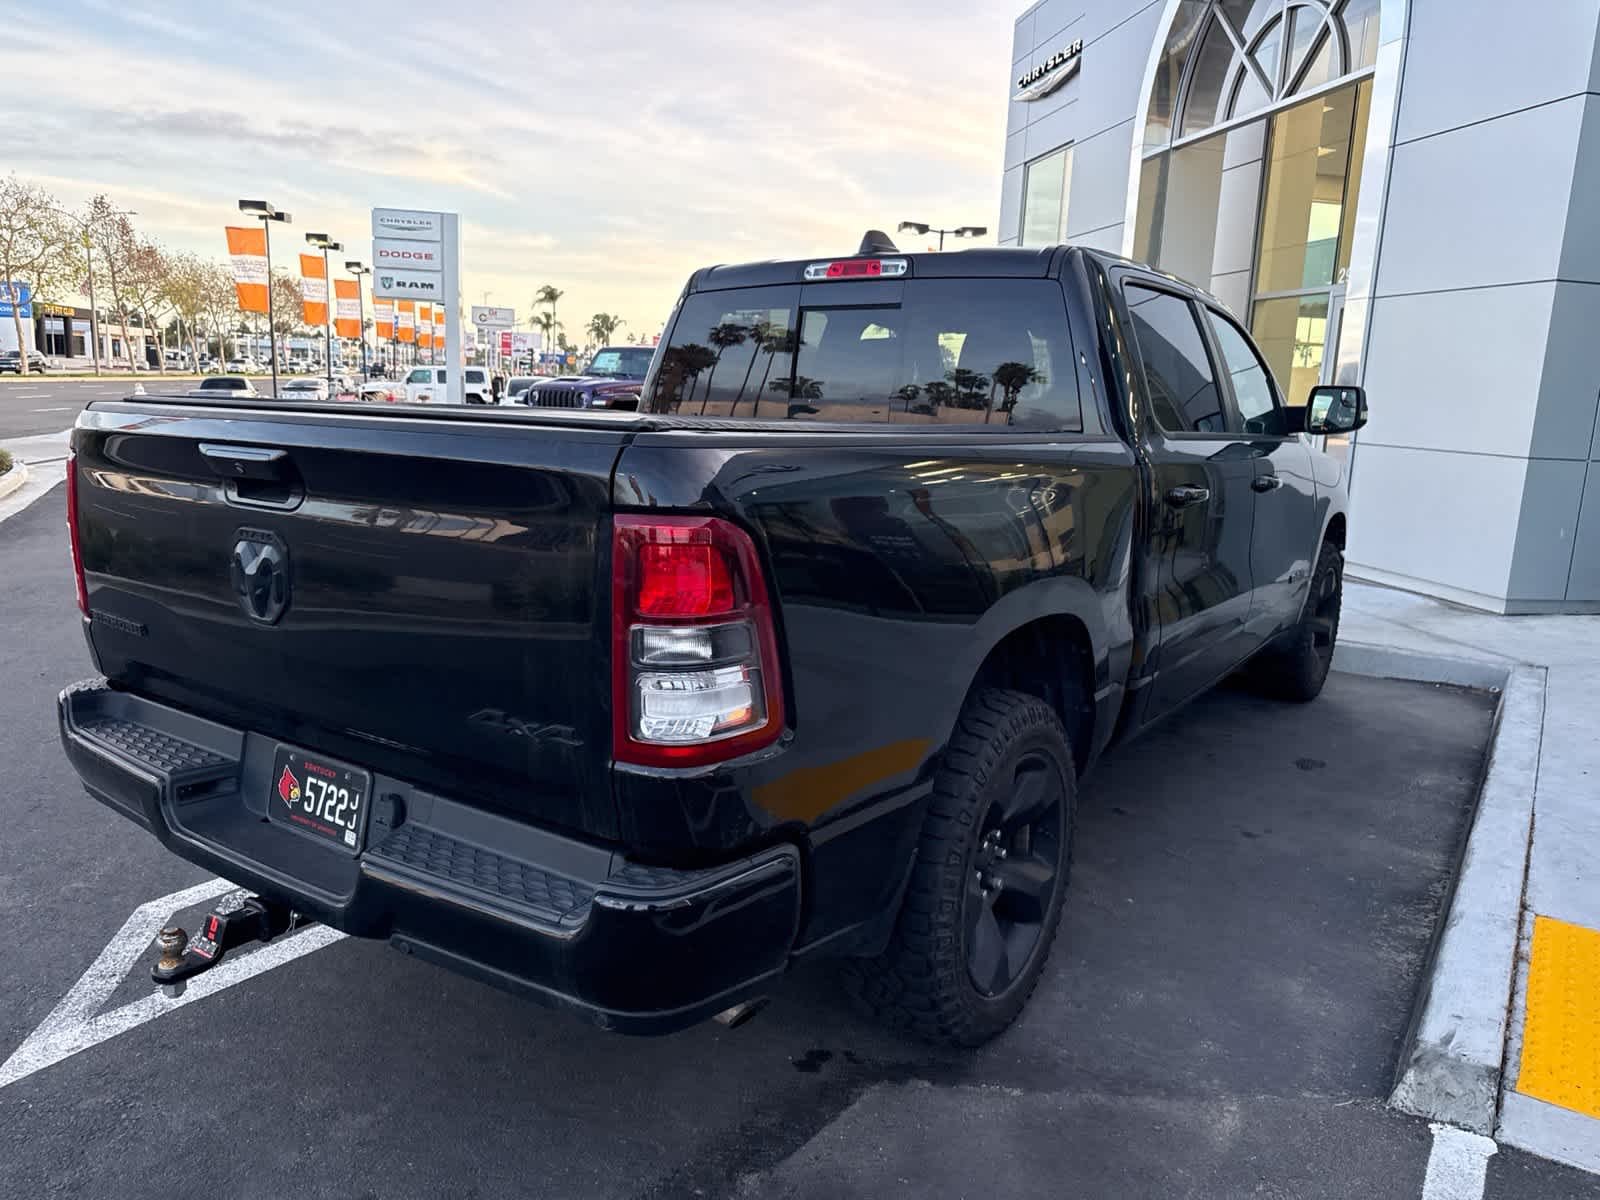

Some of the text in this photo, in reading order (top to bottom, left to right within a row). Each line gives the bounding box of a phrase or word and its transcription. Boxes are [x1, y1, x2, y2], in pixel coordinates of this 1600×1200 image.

[1017, 38, 1082, 89] CHRYSLER
[379, 217, 432, 226] CHRYSLER
[379, 250, 433, 260] DODGE
[396, 281, 435, 290] RAM
[304, 776, 348, 827] 5722
